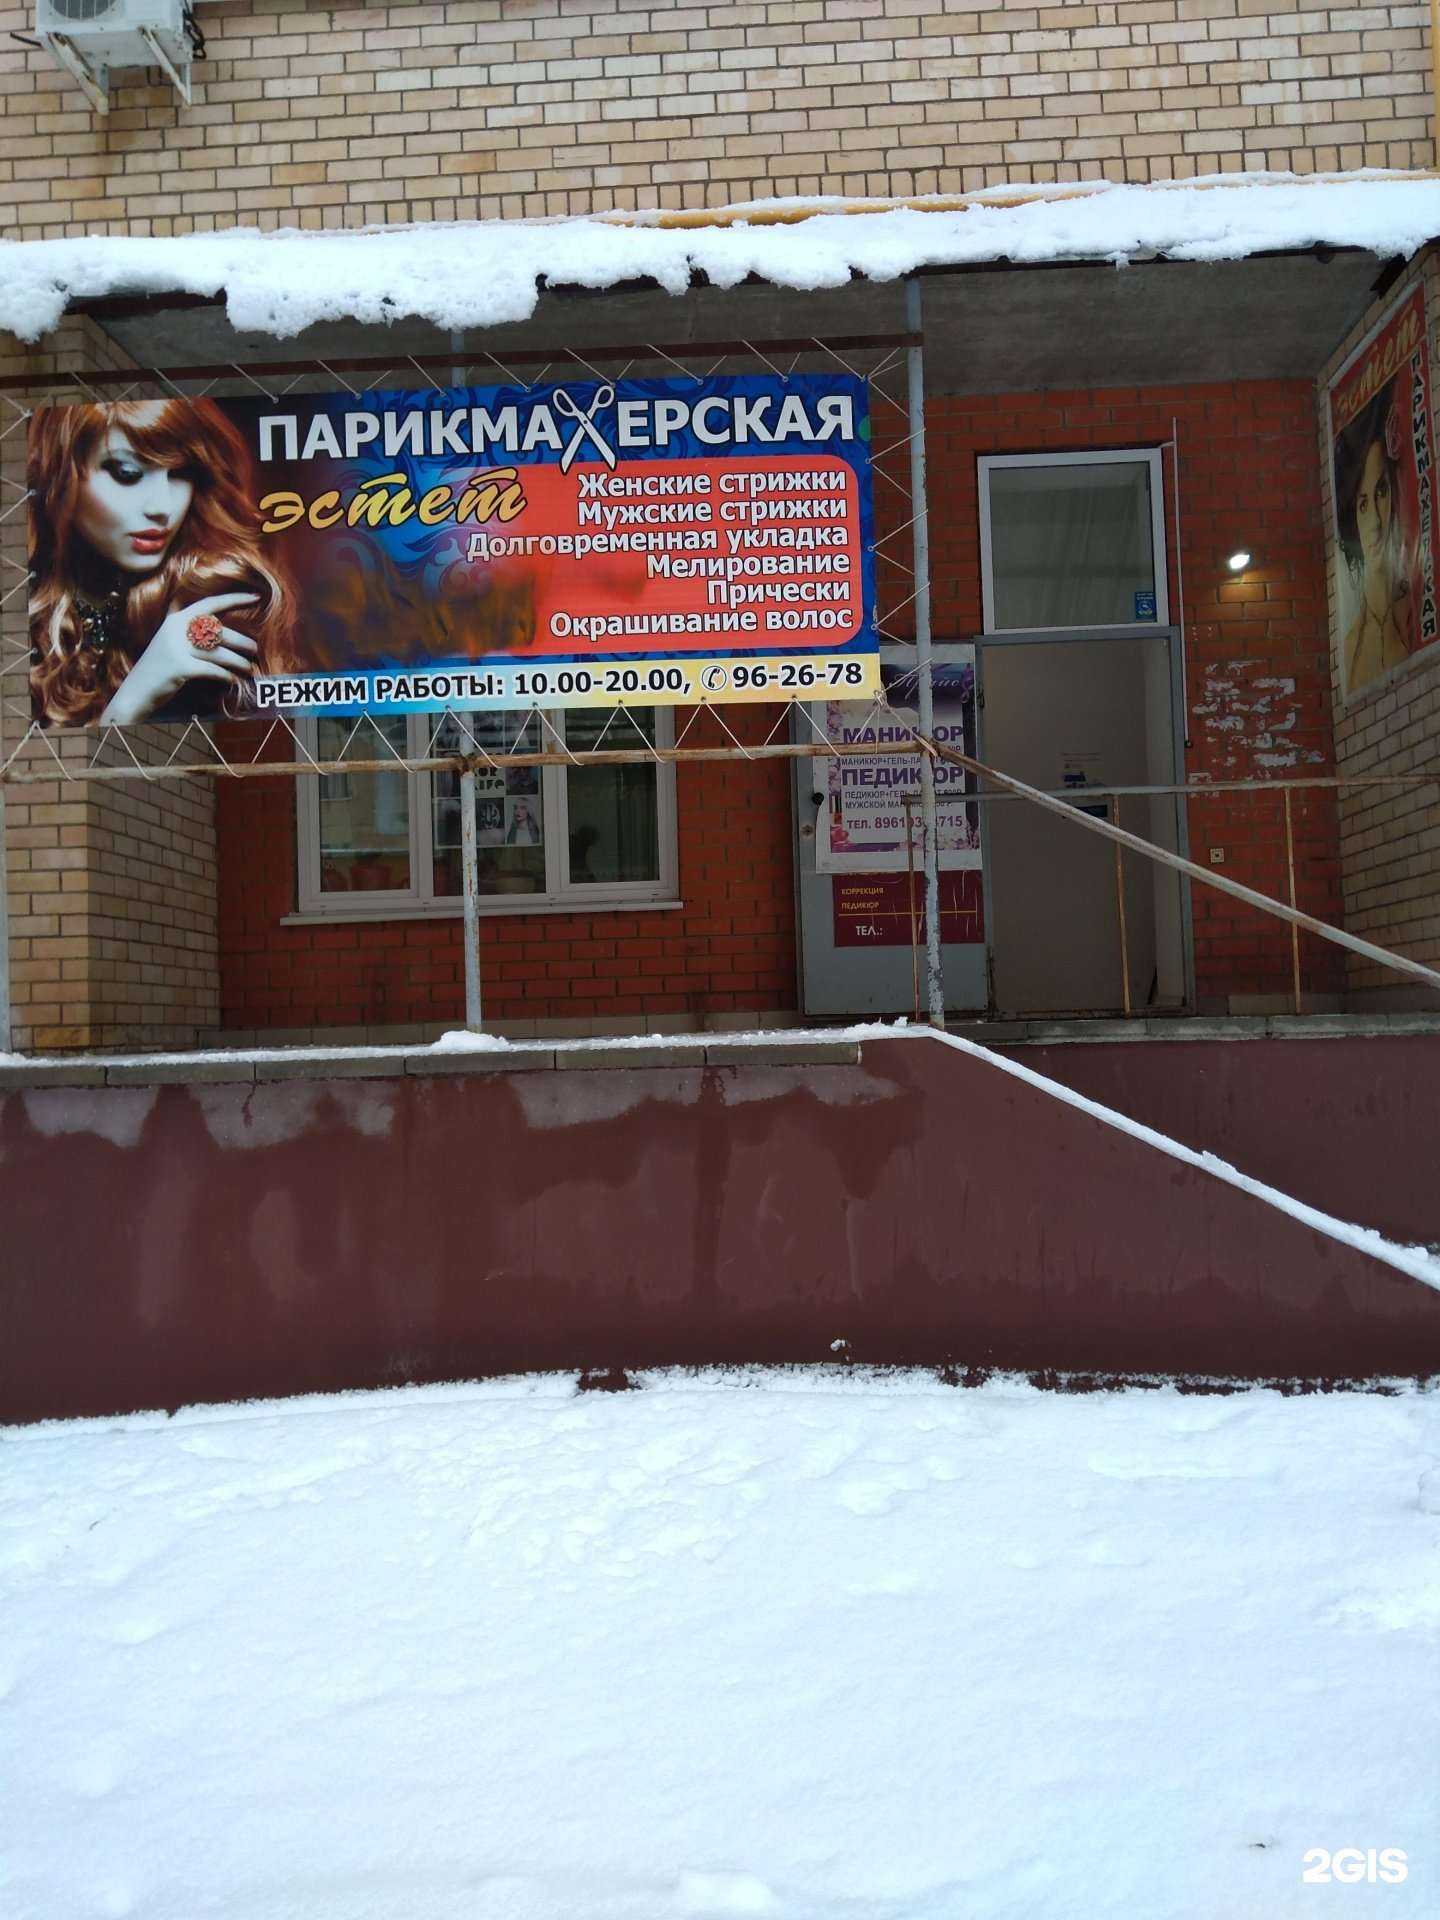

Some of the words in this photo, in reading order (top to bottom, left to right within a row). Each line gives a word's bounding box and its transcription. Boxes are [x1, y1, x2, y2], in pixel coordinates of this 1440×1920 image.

[259, 388, 854, 470] ПАРИКМАХЕРСКАЯ
[258, 467, 527, 533] эстет
[578, 473, 711, 498] Женские
[719, 471, 847, 498] стрижки
[578, 501, 712, 530] Мужские
[720, 499, 848, 525] стрижки
[467, 529, 717, 562] Долговременная
[726, 526, 849, 554] укладка
[647, 554, 850, 581] Мелирование
[707, 580, 850, 609] Прически
[550, 609, 757, 641] Окрашивание
[766, 608, 852, 630] волос
[258, 679, 367, 705] РЕЖИМ
[375, 674, 504, 700] РАБОТЫ:
[514, 668, 691, 696] 10.00-20.00,
[732, 663, 863, 689] 96-26-78
